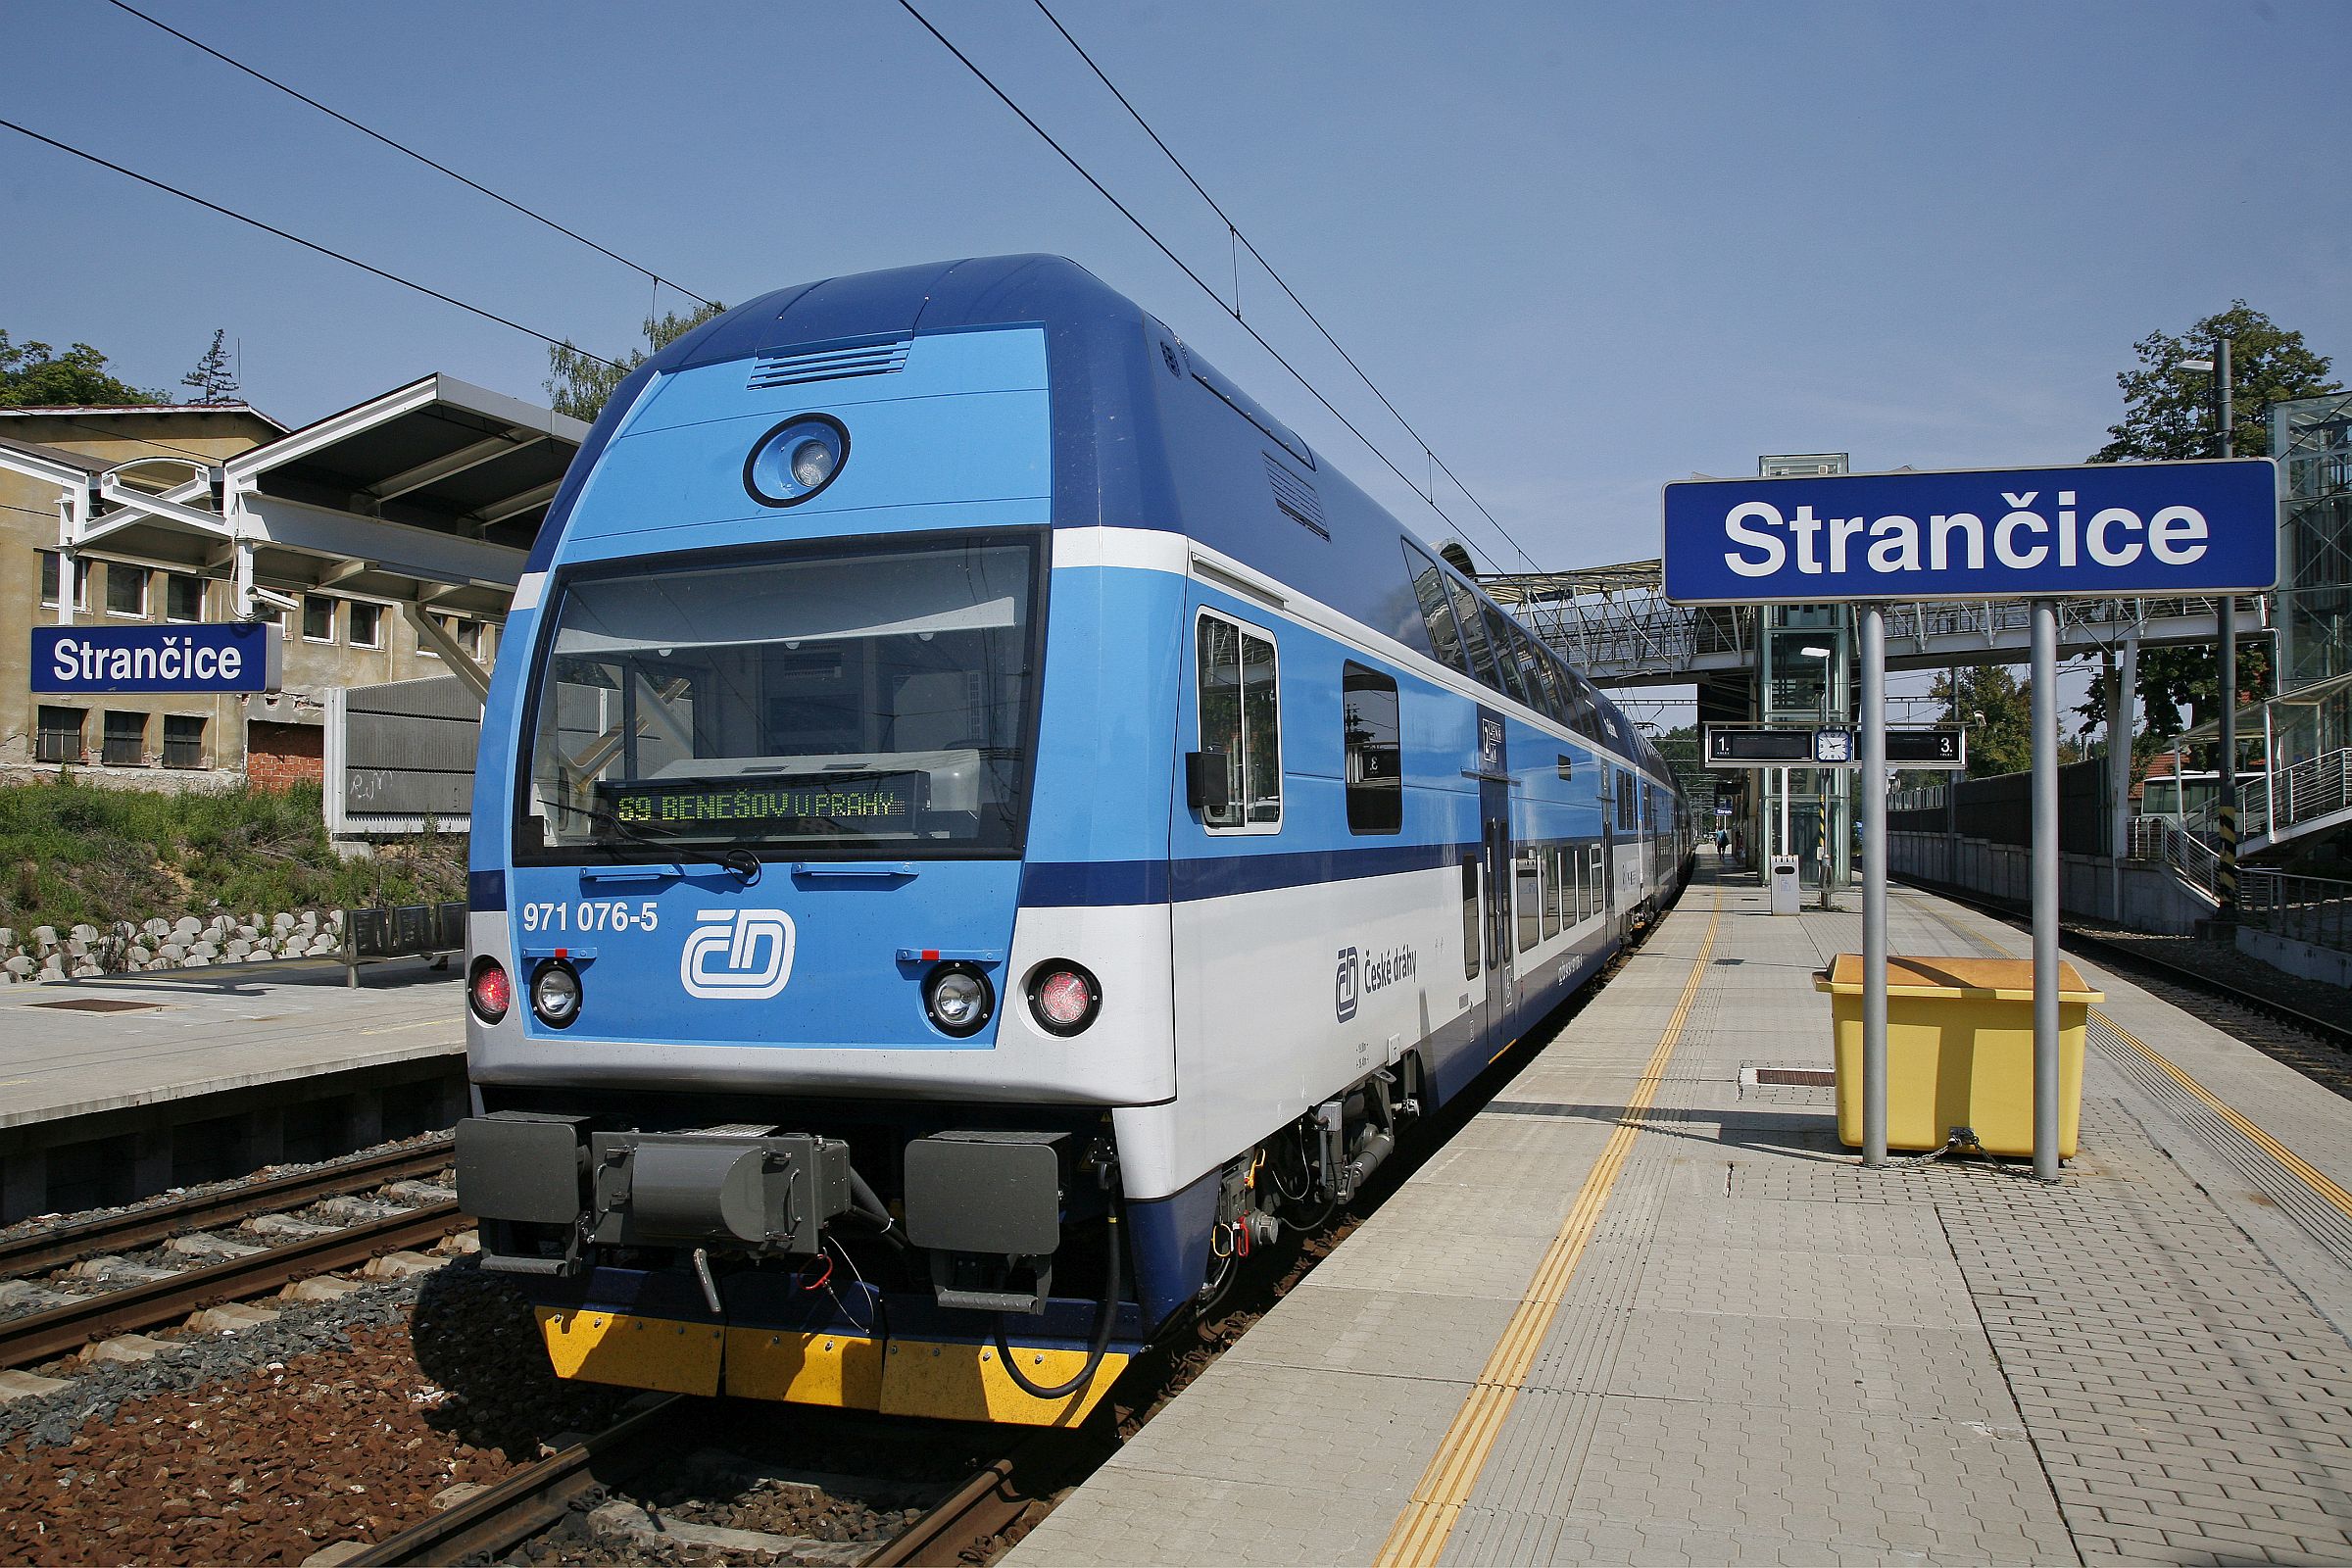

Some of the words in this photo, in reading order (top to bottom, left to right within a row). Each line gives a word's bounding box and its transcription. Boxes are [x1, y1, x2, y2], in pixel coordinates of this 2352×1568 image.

[1724, 490, 2209, 577] Strančice
[53, 636, 242, 681] Strančice
[1718, 736, 1730, 752] 1.
[1940, 737, 1953, 753] 3.
[618, 796, 652, 821] S9
[662, 787, 789, 820] BENEŠOV
[795, 794, 809, 816] U
[815, 792, 895, 816] PRAHY
[523, 902, 568, 931] 971
[577, 902, 659, 931] 076-5
[1364, 949, 1392, 994] České
[1393, 943, 1417, 984] dráhy
